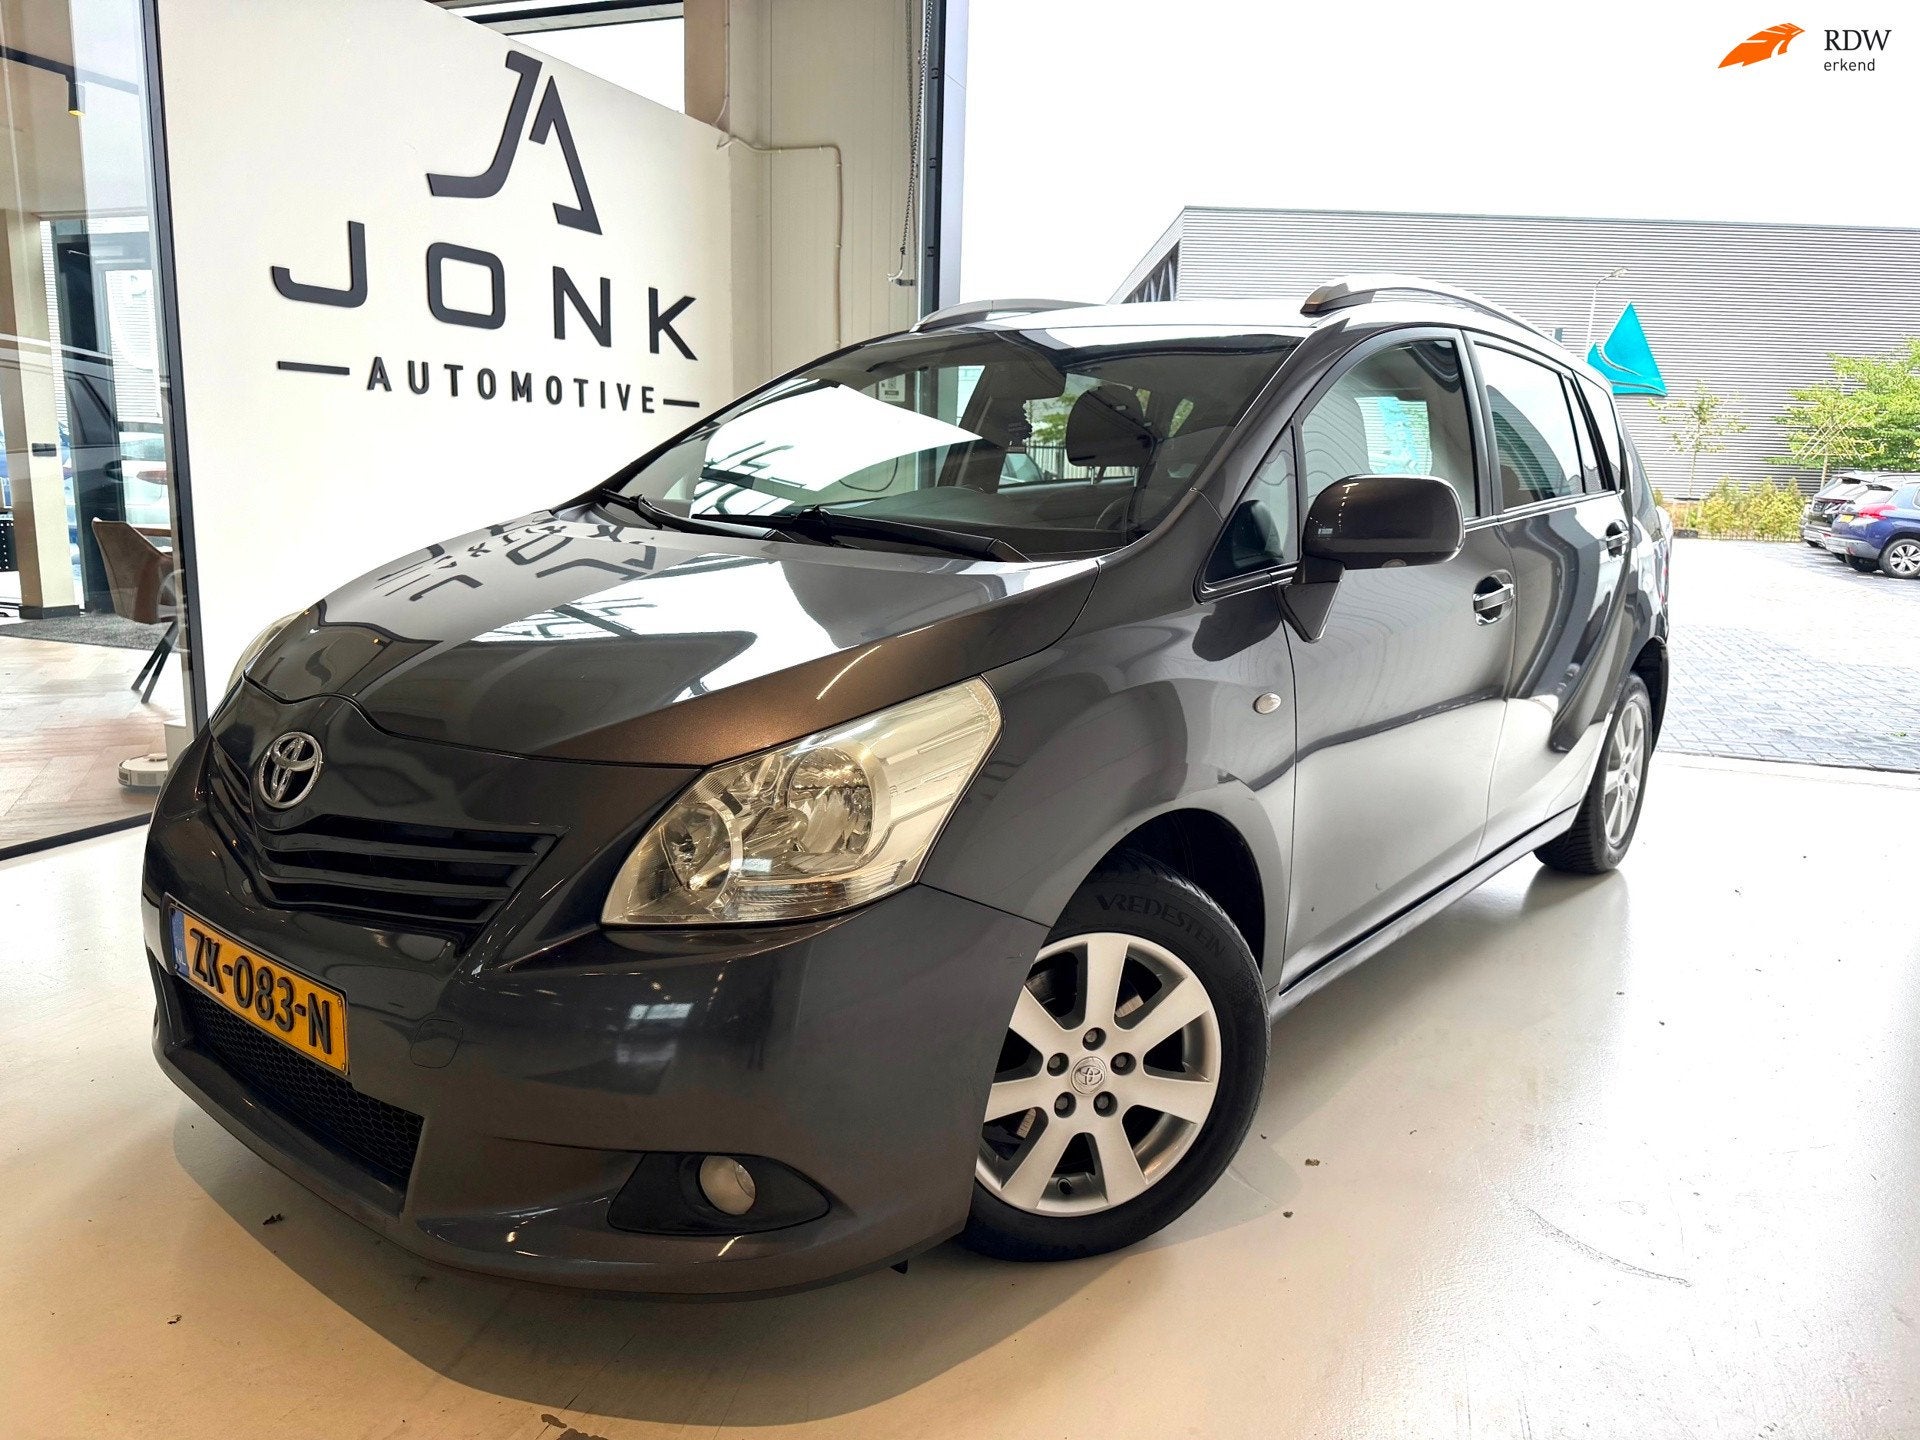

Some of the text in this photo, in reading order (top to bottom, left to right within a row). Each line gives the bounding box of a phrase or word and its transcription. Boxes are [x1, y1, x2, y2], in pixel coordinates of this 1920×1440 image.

[271, 220, 698, 361] JONK
[366, 356, 655, 414] AUTOMOTIVE
[1096, 894, 1226, 957] VREDESTEIN
[174, 927, 333, 1055] NL ZK-083-N
